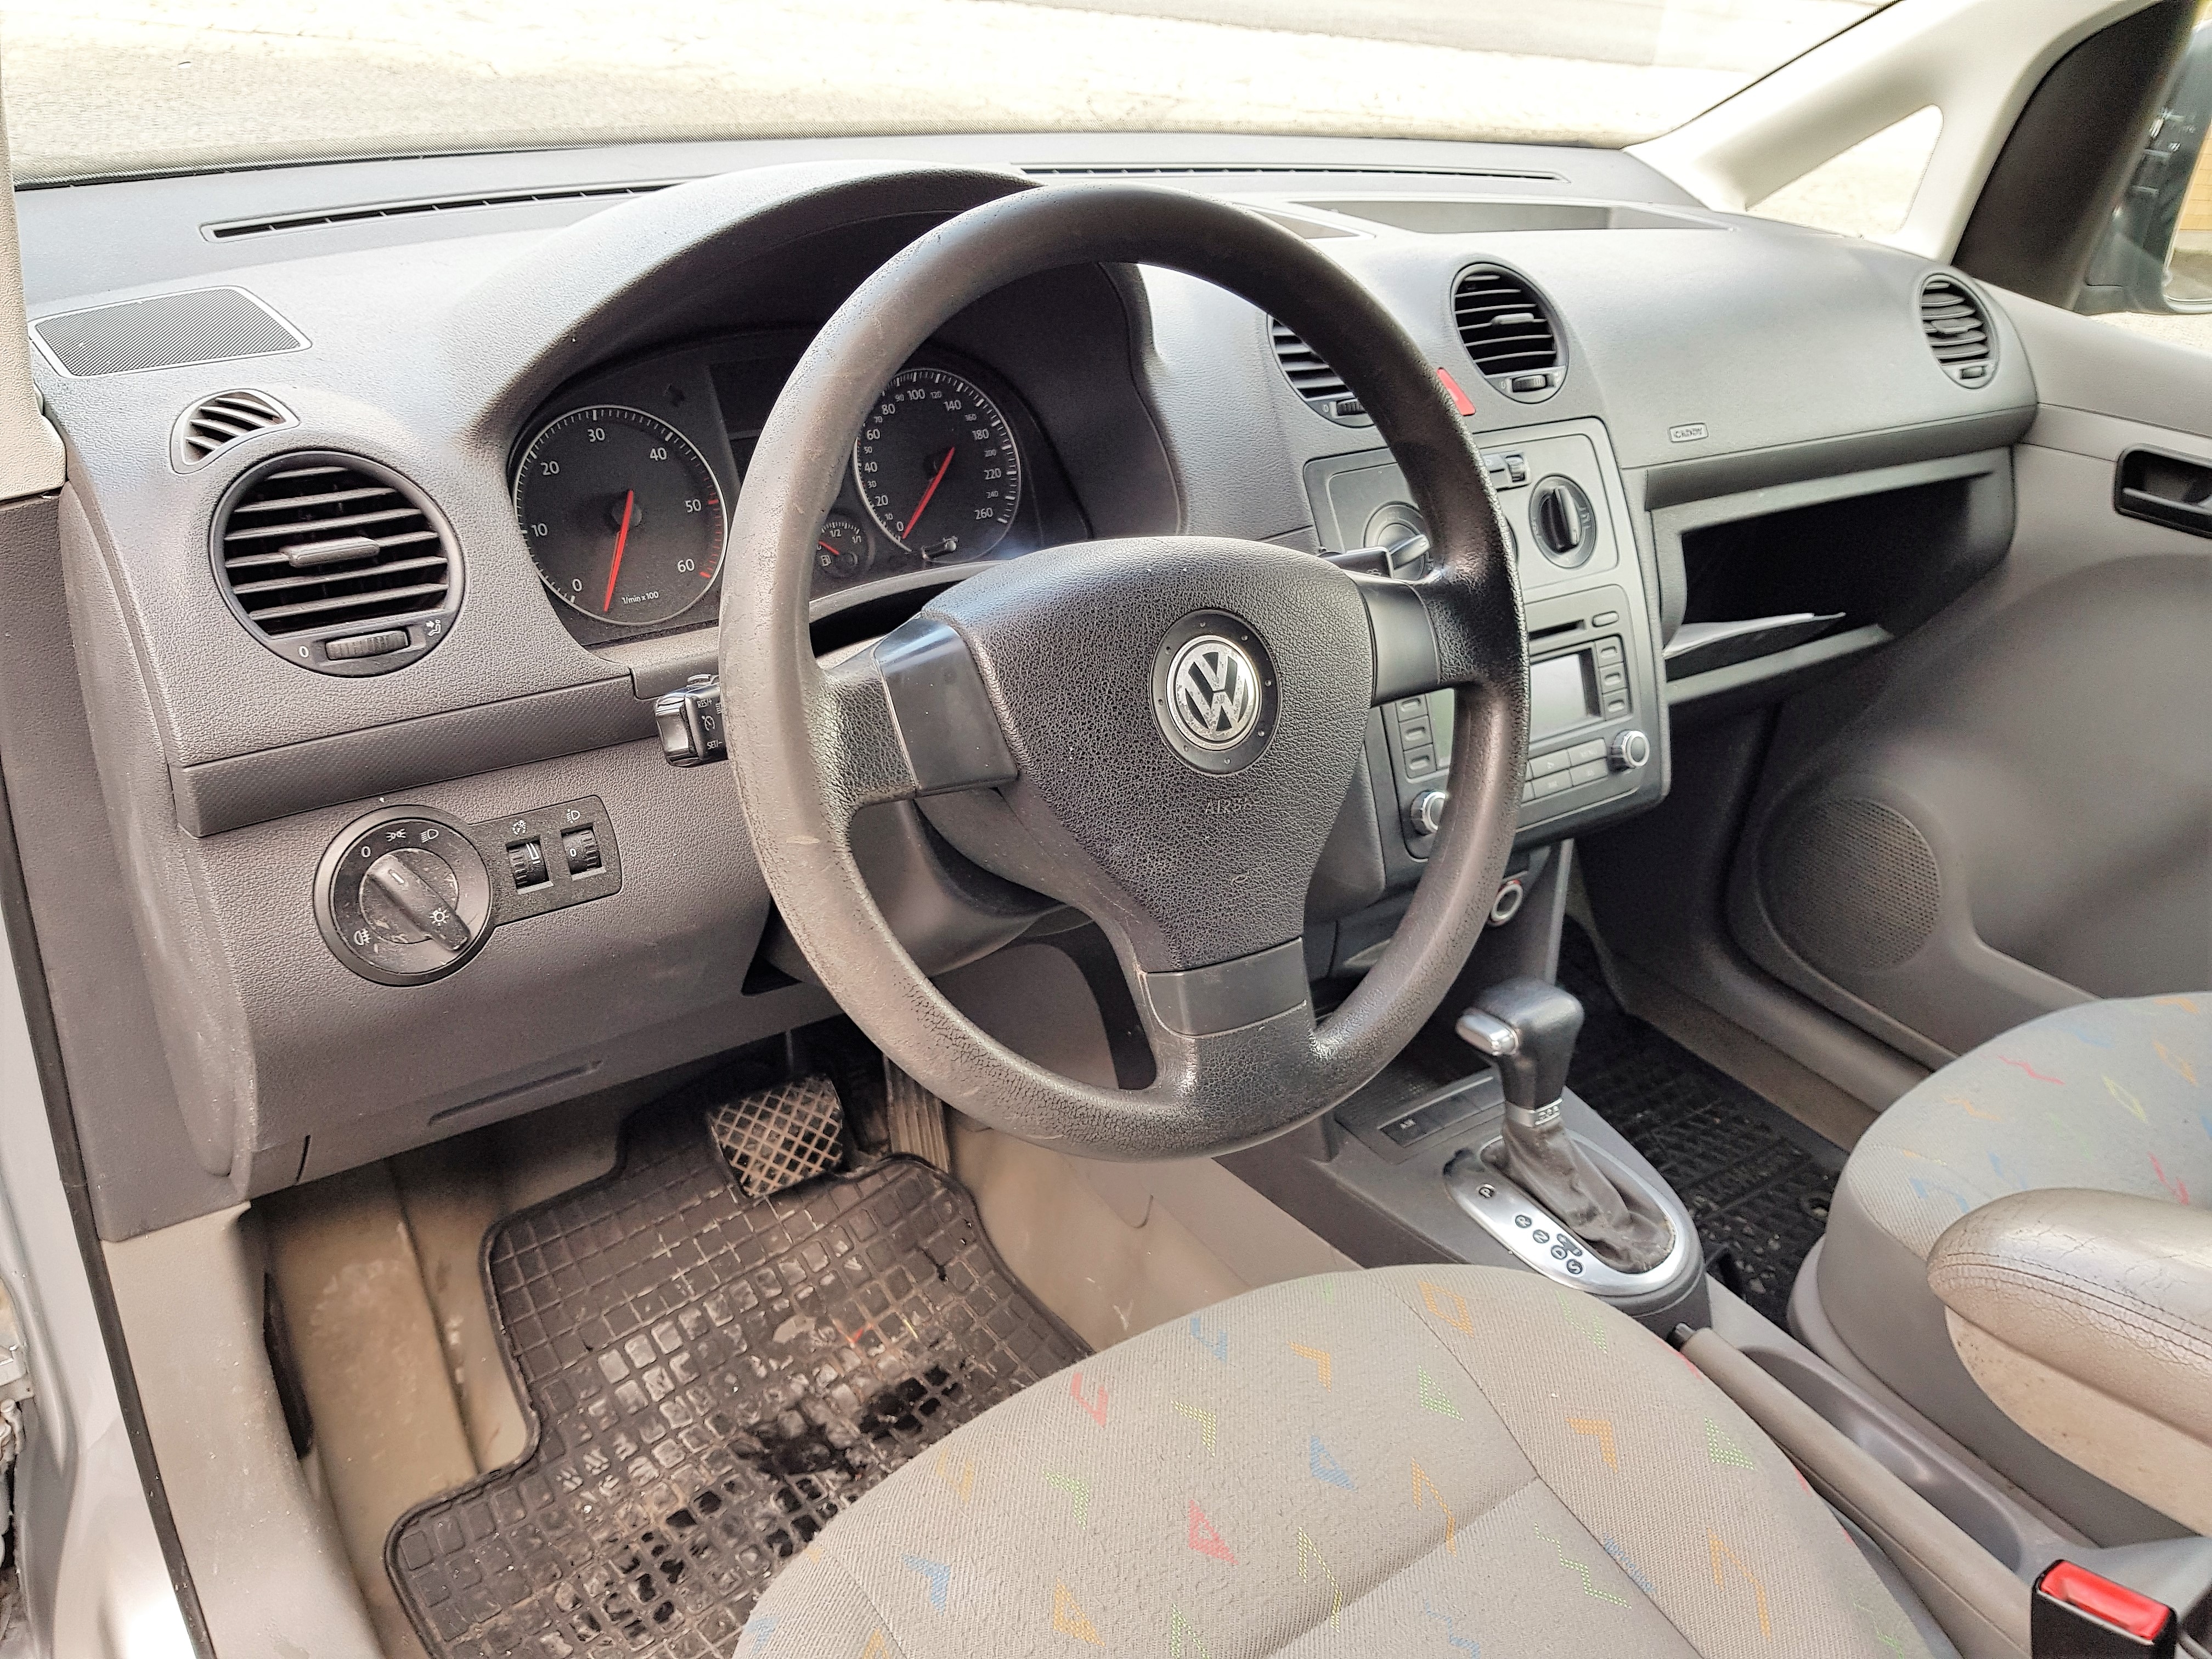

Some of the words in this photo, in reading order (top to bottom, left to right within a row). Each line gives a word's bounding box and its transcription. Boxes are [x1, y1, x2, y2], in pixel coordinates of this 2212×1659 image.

[895, 394, 905, 402] 90
[907, 388, 926, 400] 100
[930, 391, 942, 399] 120
[881, 403, 896, 415] 80
[943, 399, 962, 411] 140
[588, 428, 605, 442] 30
[866, 428, 881, 441] 60
[972, 428, 989, 440] 180
[650, 448, 667, 461] 40
[864, 446, 873, 454] 50
[540, 461, 560, 476] 20
[864, 461, 878, 473] 40
[984, 468, 1002, 480] 220
[867, 481, 877, 489] 30
[685, 499, 702, 513] 50
[874, 495, 889, 507] 20
[974, 507, 994, 520] 260
[531, 523, 548, 537] 10
[896, 521, 904, 532] 0
[830, 529, 842, 538] 1/2
[851, 535, 862, 544] 1/1
[677, 558, 695, 573] 60
[572, 579, 583, 592] 0
[622, 594, 641, 604] 1/min
[646, 591, 659, 600] 100
[298, 646, 309, 658] 0
[360, 845, 371, 859] 0
[569, 848, 577, 858] 0
[1516, 1216, 1531, 1227] R
[1533, 1231, 1549, 1243] N
[1551, 1246, 1566, 1259] D
[1568, 1261, 1581, 1273] S
